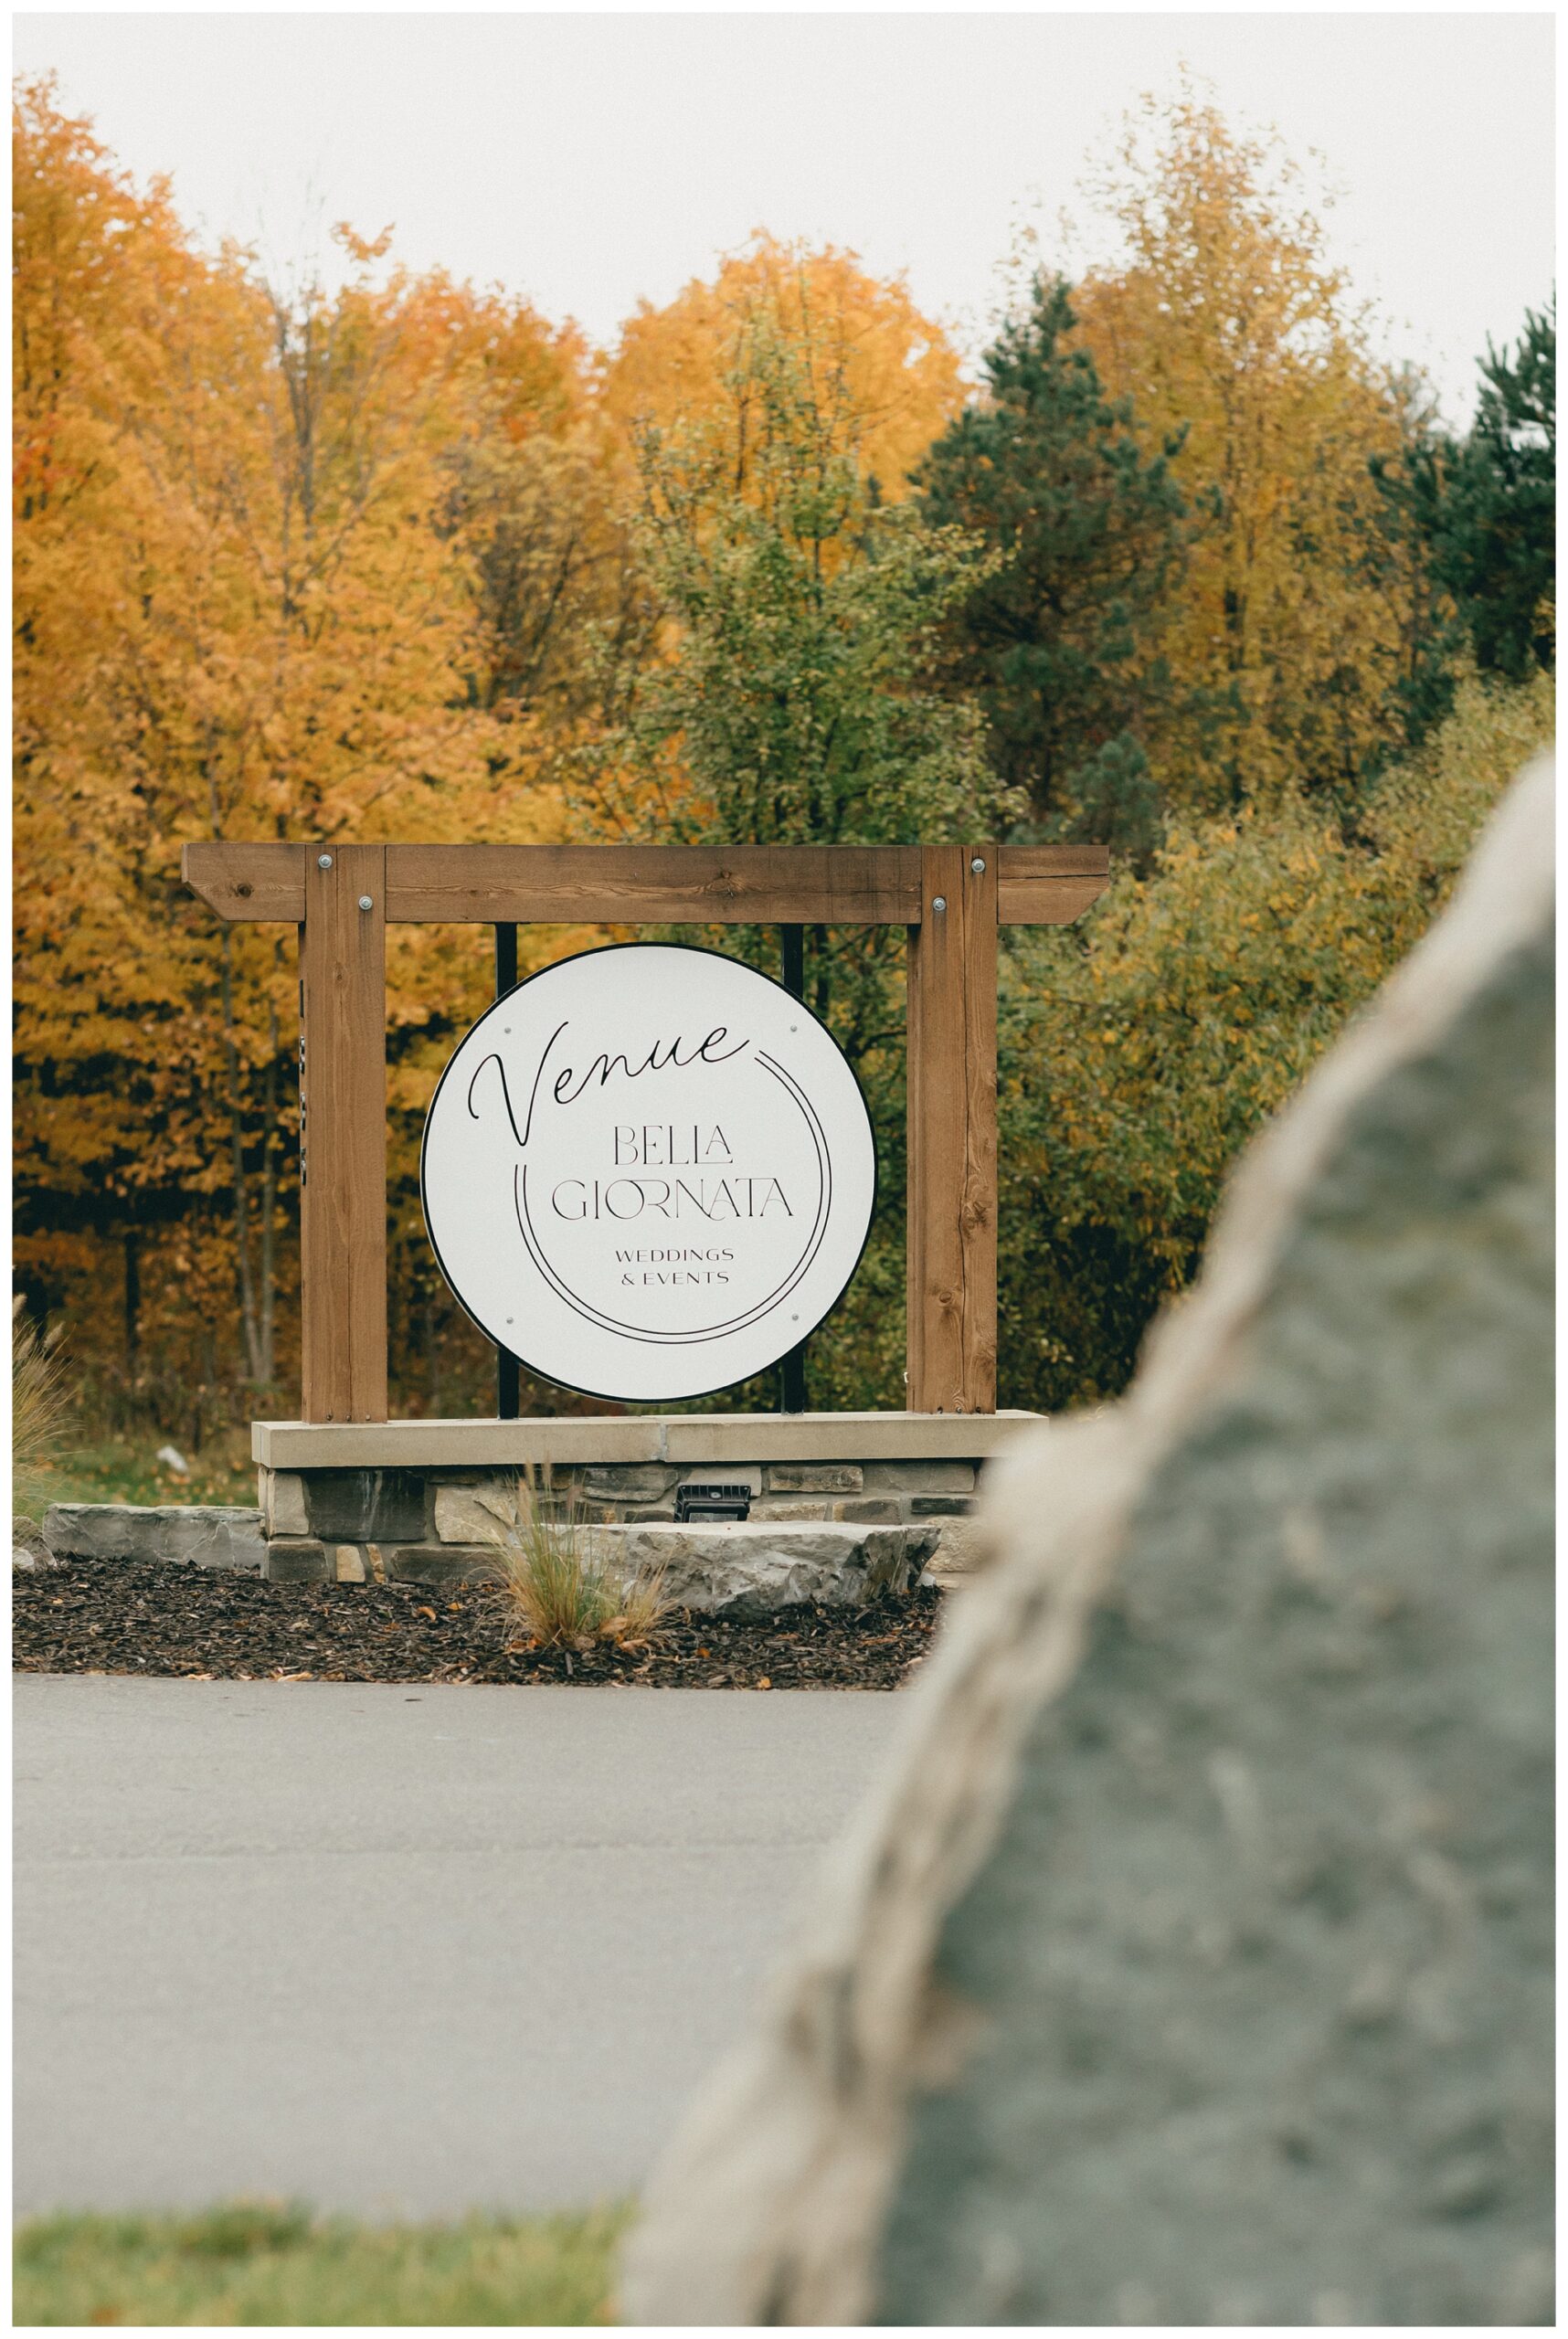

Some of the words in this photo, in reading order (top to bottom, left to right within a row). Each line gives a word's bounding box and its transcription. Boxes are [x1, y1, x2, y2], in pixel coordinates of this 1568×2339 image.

[467, 1021, 750, 1148] Venue
[614, 1124, 734, 1166] BELLA
[551, 1177, 795, 1222] GIORNATA
[615, 1248, 735, 1263] WEDDINGS
[621, 1273, 636, 1286] &
[643, 1271, 730, 1286] EVENTS
